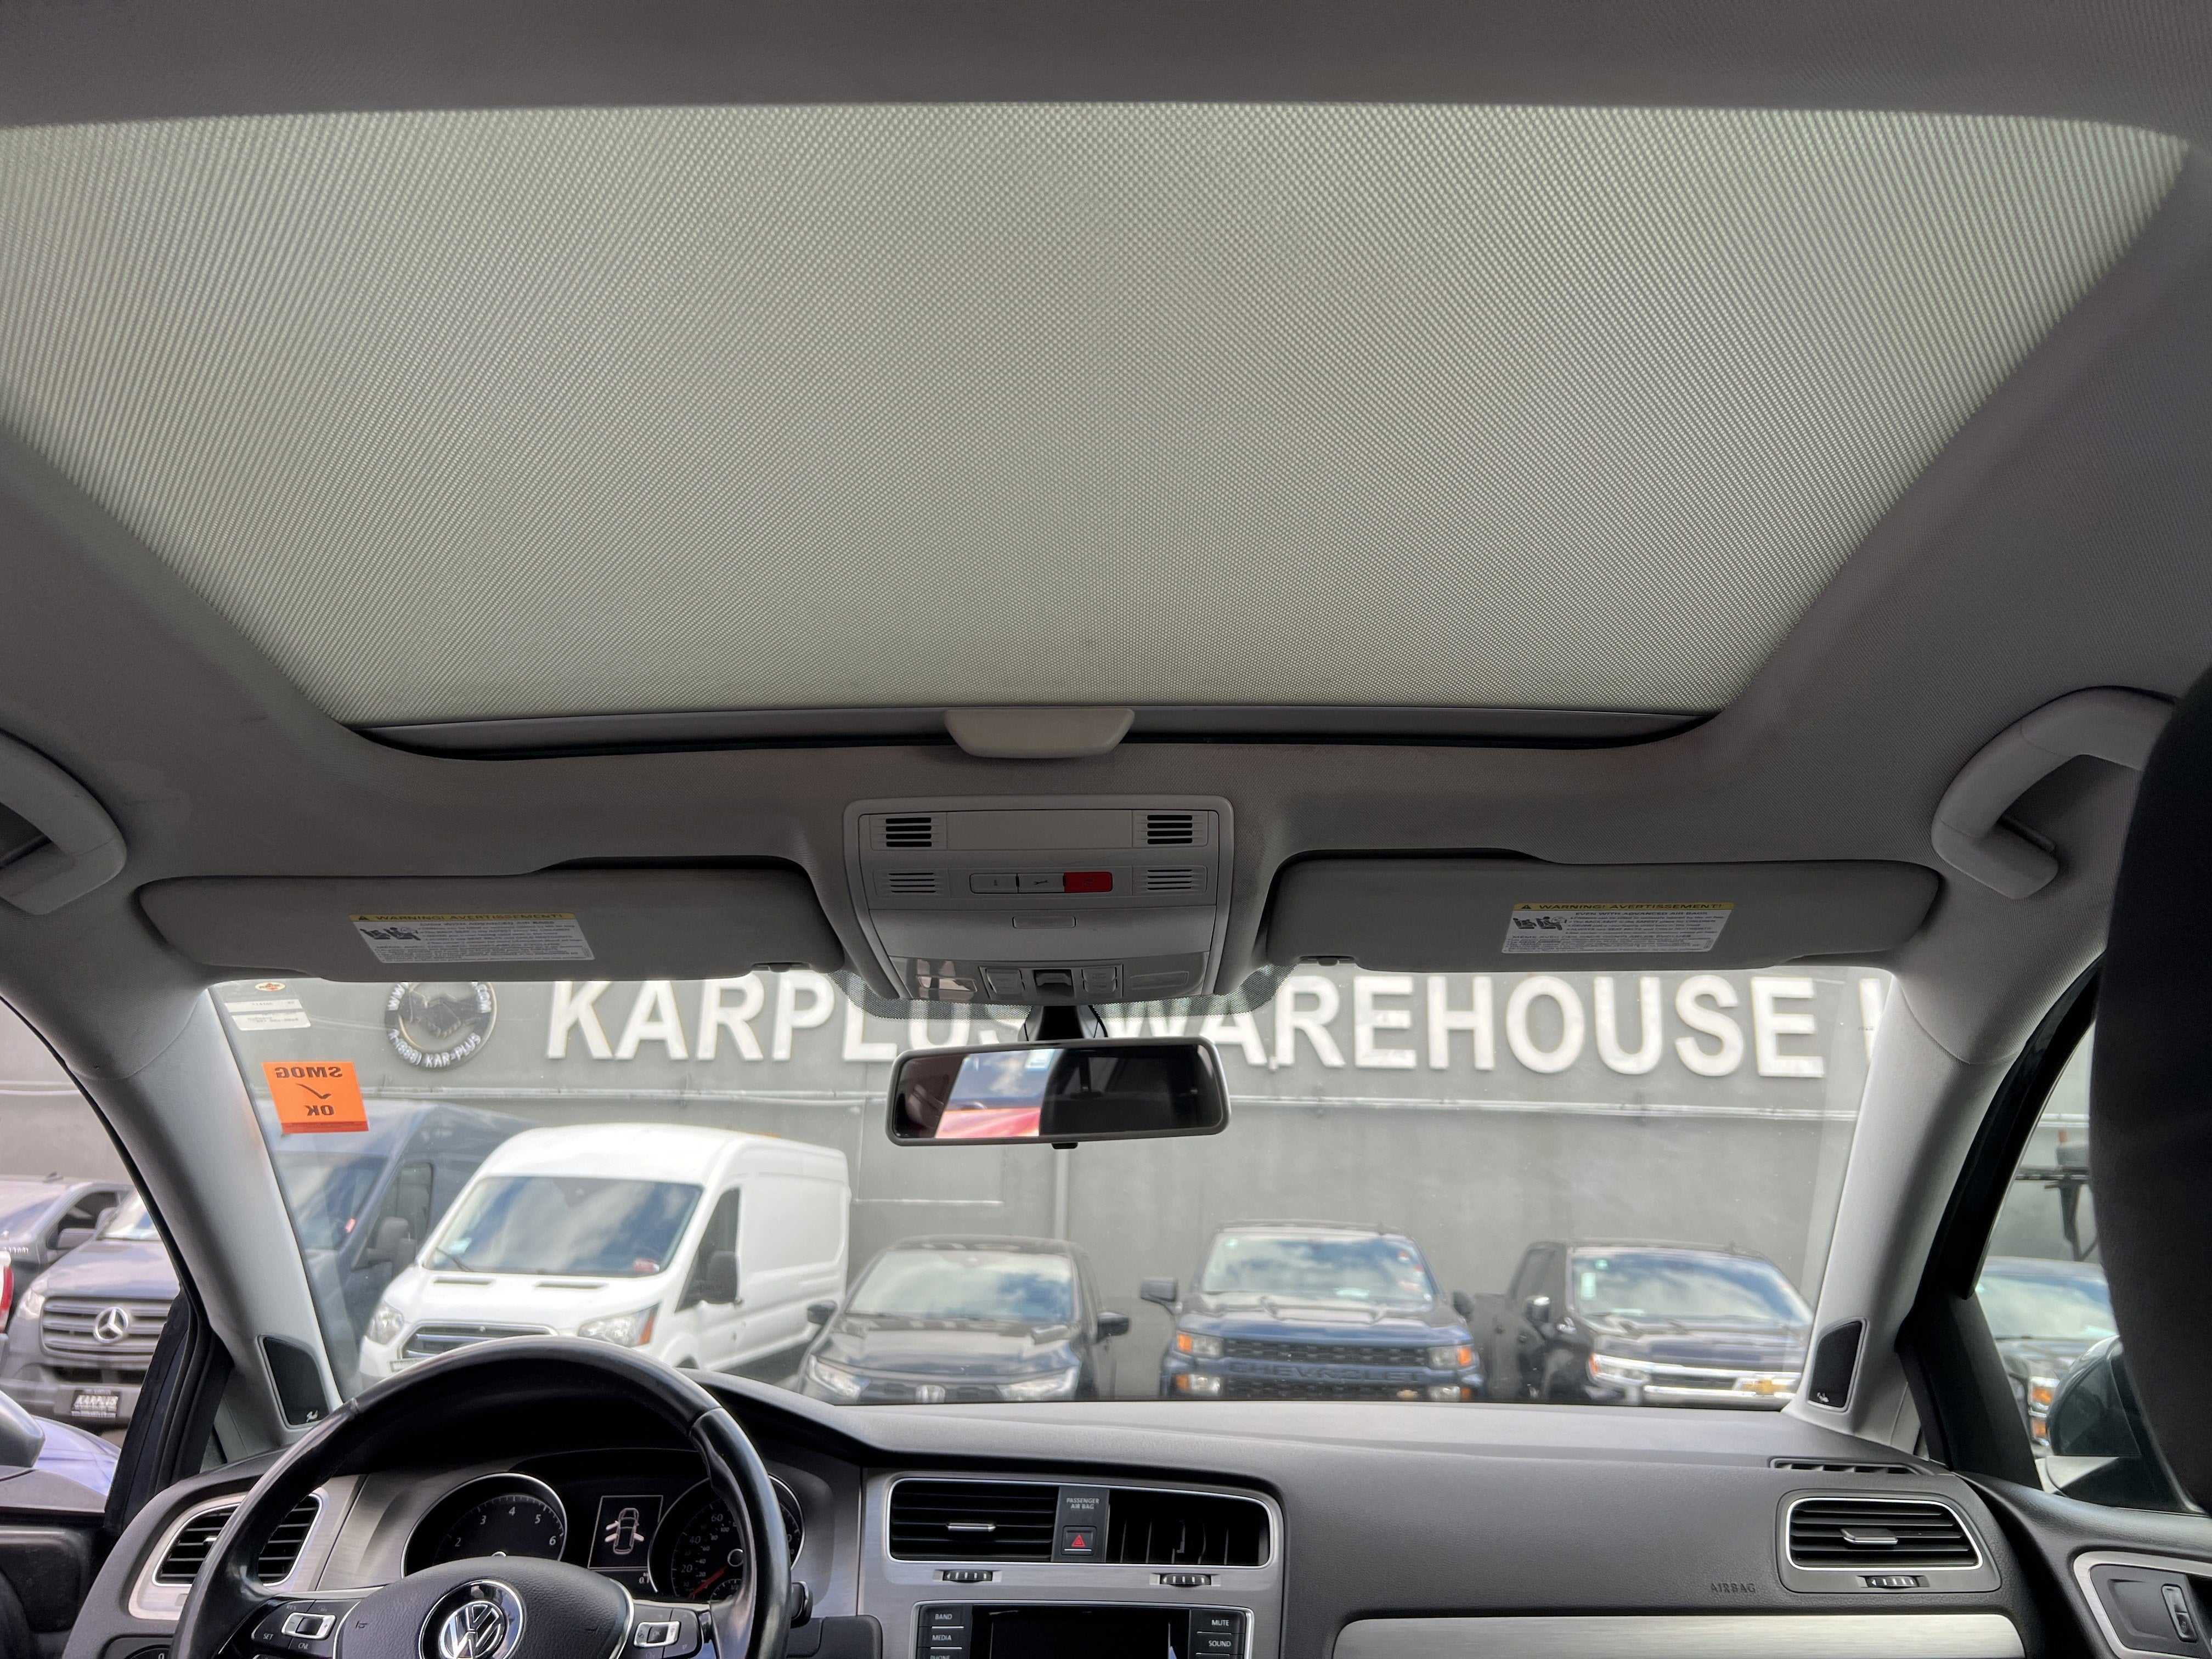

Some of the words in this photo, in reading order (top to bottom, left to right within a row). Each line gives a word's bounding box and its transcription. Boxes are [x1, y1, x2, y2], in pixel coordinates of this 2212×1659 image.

[422, 1032, 481, 1068] KAR-PLUS
[508, 1506, 516, 1517] 4
[479, 1515, 487, 1525] 3
[534, 1514, 541, 1525] 5
[710, 1513, 724, 1522] 60
[454, 1537, 461, 1548] 2
[549, 1536, 556, 1547] 6
[689, 1536, 701, 1544] 40
[681, 1564, 693, 1573] 20
[1711, 1582, 1756, 1594] AIRBAG
[262, 1632, 274, 1640] SET
